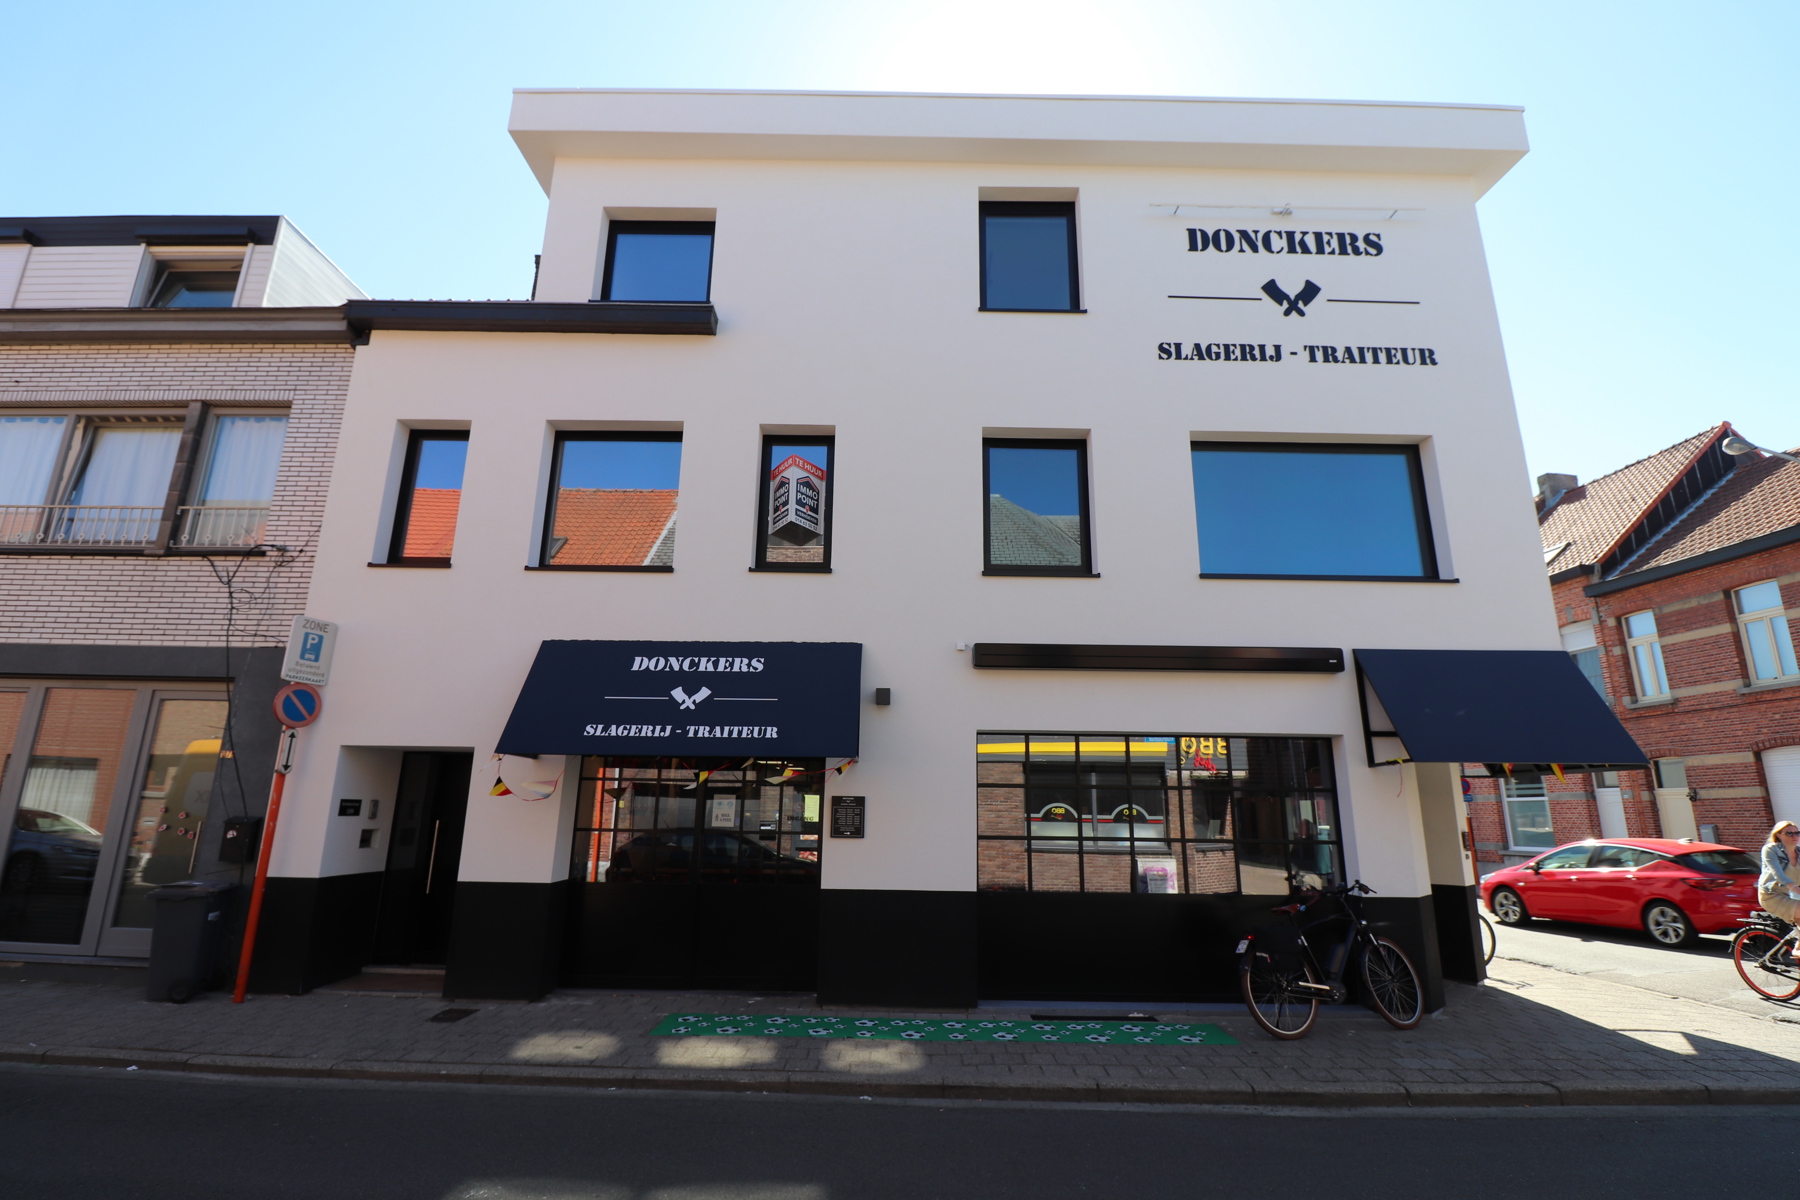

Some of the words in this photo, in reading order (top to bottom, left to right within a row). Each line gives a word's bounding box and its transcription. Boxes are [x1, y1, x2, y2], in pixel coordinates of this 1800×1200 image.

[1186, 228, 1384, 257] DONCKERS
[1157, 342, 1283, 363] SLAGERIJ
[1303, 345, 1439, 366] TRAITEUR
[795, 457, 804, 467] TE
[804, 461, 823, 478] HUUR
[775, 484, 789, 499] IMMO
[797, 483, 818, 500] IMMO
[774, 492, 789, 508] POINT
[797, 492, 818, 509] POINT
[302, 618, 330, 633] ZONE
[306, 634, 319, 649] P
[287, 667, 325, 678] uitgezonderd
[295, 661, 321, 670] Betalend
[630, 656, 765, 673] DONCKERS
[285, 673, 325, 684] PARKEERKAART
[583, 723, 673, 737] SLAGERIJ
[686, 725, 779, 739] TRAITEUR
